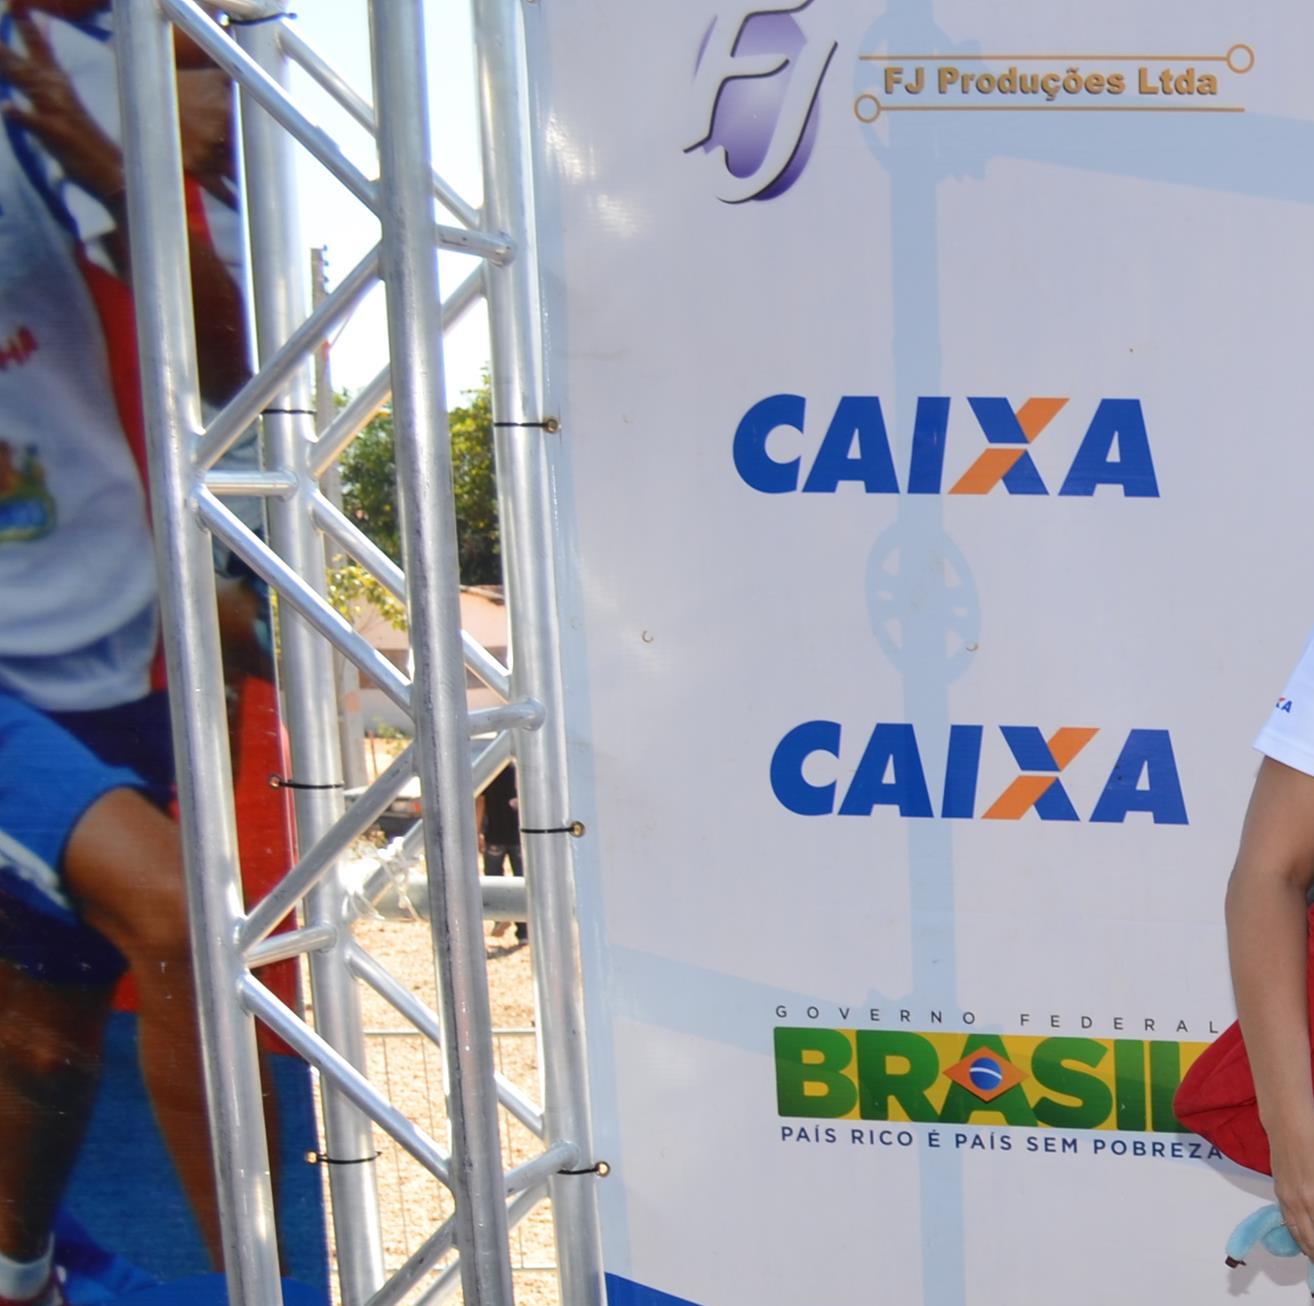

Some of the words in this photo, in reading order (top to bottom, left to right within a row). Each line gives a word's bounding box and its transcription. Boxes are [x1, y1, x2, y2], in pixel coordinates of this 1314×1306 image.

[883, 67, 927, 95] FJ
[937, 67, 1126, 101] Produções
[1137, 67, 1219, 97] Ltda
[732, 393, 1160, 498] CAIXA
[770, 719, 1190, 825] CAIXA
[775, 1005, 976, 1026] GOVERNO
[1019, 1013, 1219, 1034] FEDERAL
[780, 1125, 837, 1146] PAÍS
[851, 1128, 913, 1148] RICO
[928, 1127, 941, 1149] É
[954, 1130, 1012, 1152] PAÍS
[1026, 1135, 1079, 1154] SEM
[1094, 1138, 1222, 1160] POBREZA
